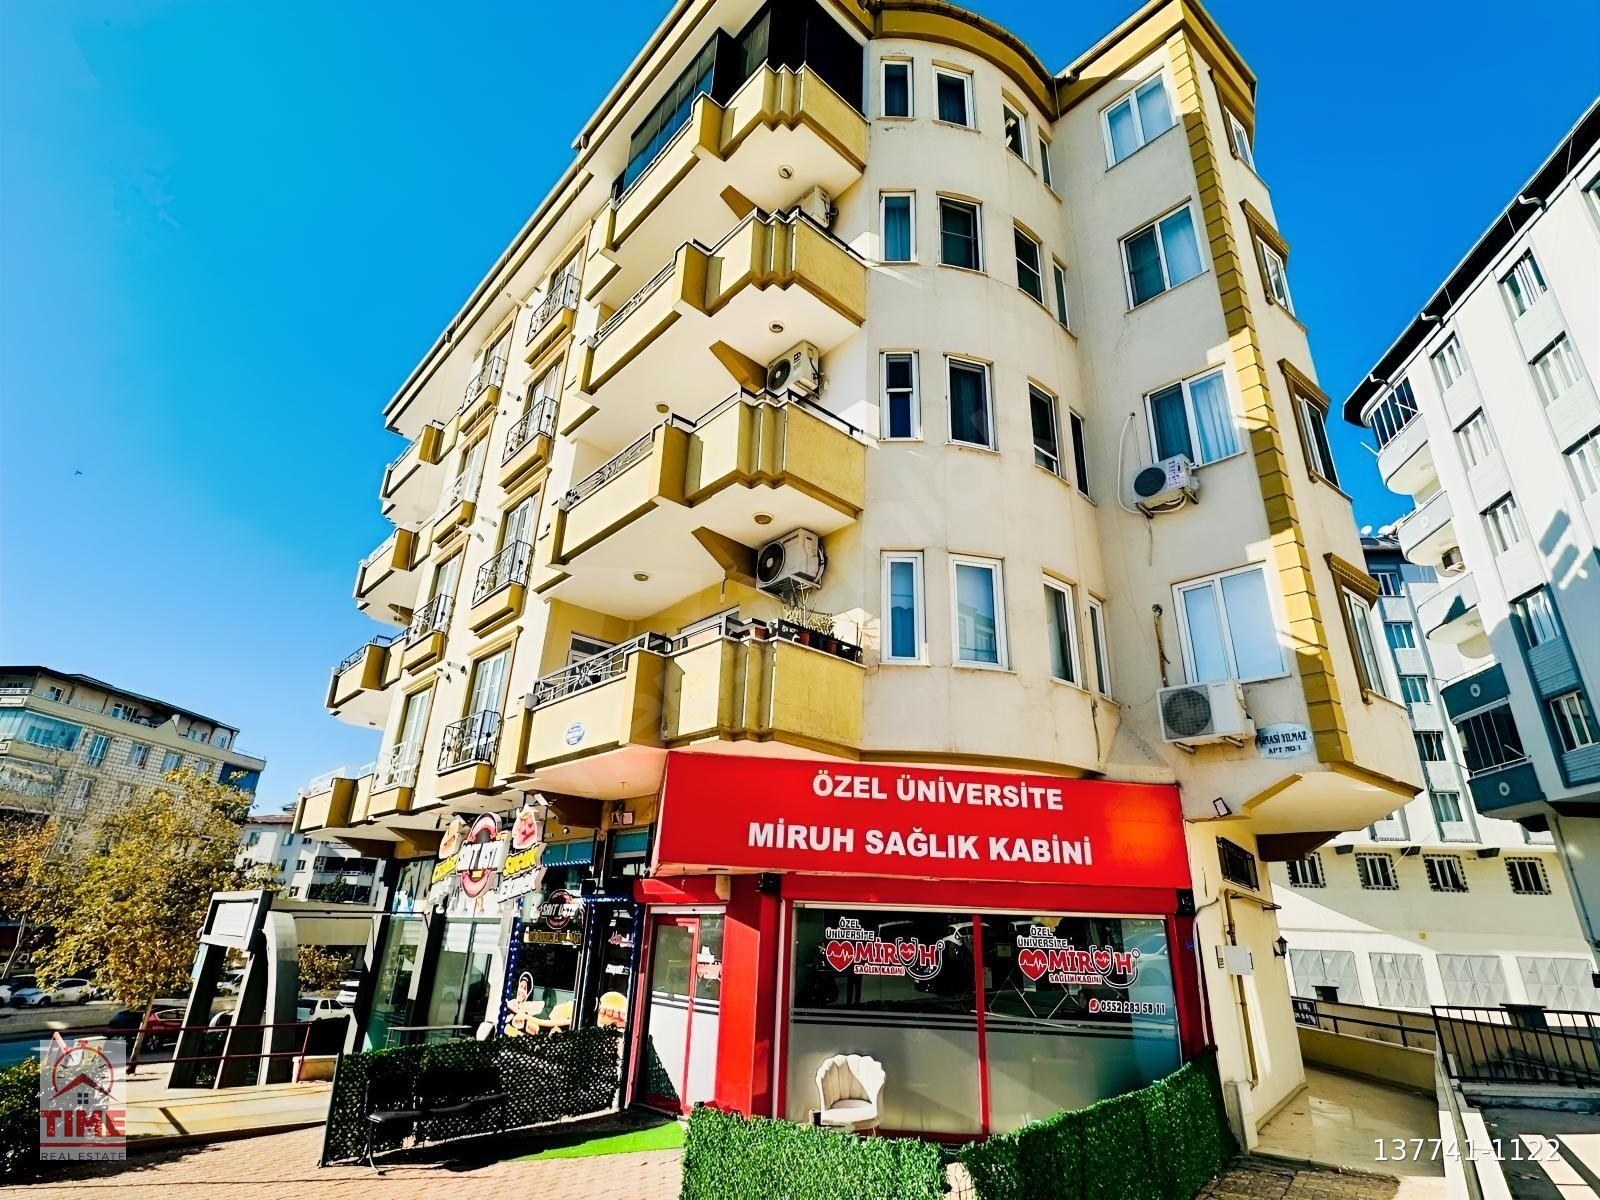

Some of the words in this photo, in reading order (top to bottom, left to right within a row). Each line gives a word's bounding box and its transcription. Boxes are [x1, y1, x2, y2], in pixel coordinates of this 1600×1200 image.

[812, 769, 888, 800] ÖZEL
[896, 774, 1064, 810] ÜNİVERSİTE
[748, 818, 854, 853] MİRUH
[865, 826, 980, 860] SAĞLIK
[989, 834, 1093, 866] KABİNİ
[839, 916, 861, 929] ÖZEL
[825, 927, 874, 940] ÜNİVERSİTE
[1030, 925, 1053, 937] ÖZEL
[1017, 935, 1067, 948] ÜNİVERSİTE
[854, 963, 880, 975] SAĞLIK
[1049, 972, 1075, 983] SAĞLIK
[1101, 1000, 1122, 1013] 0552
[1124, 1001, 1140, 1013] 283
[1142, 1002, 1153, 1014] 58
[1155, 1003, 1166, 1015] 11
